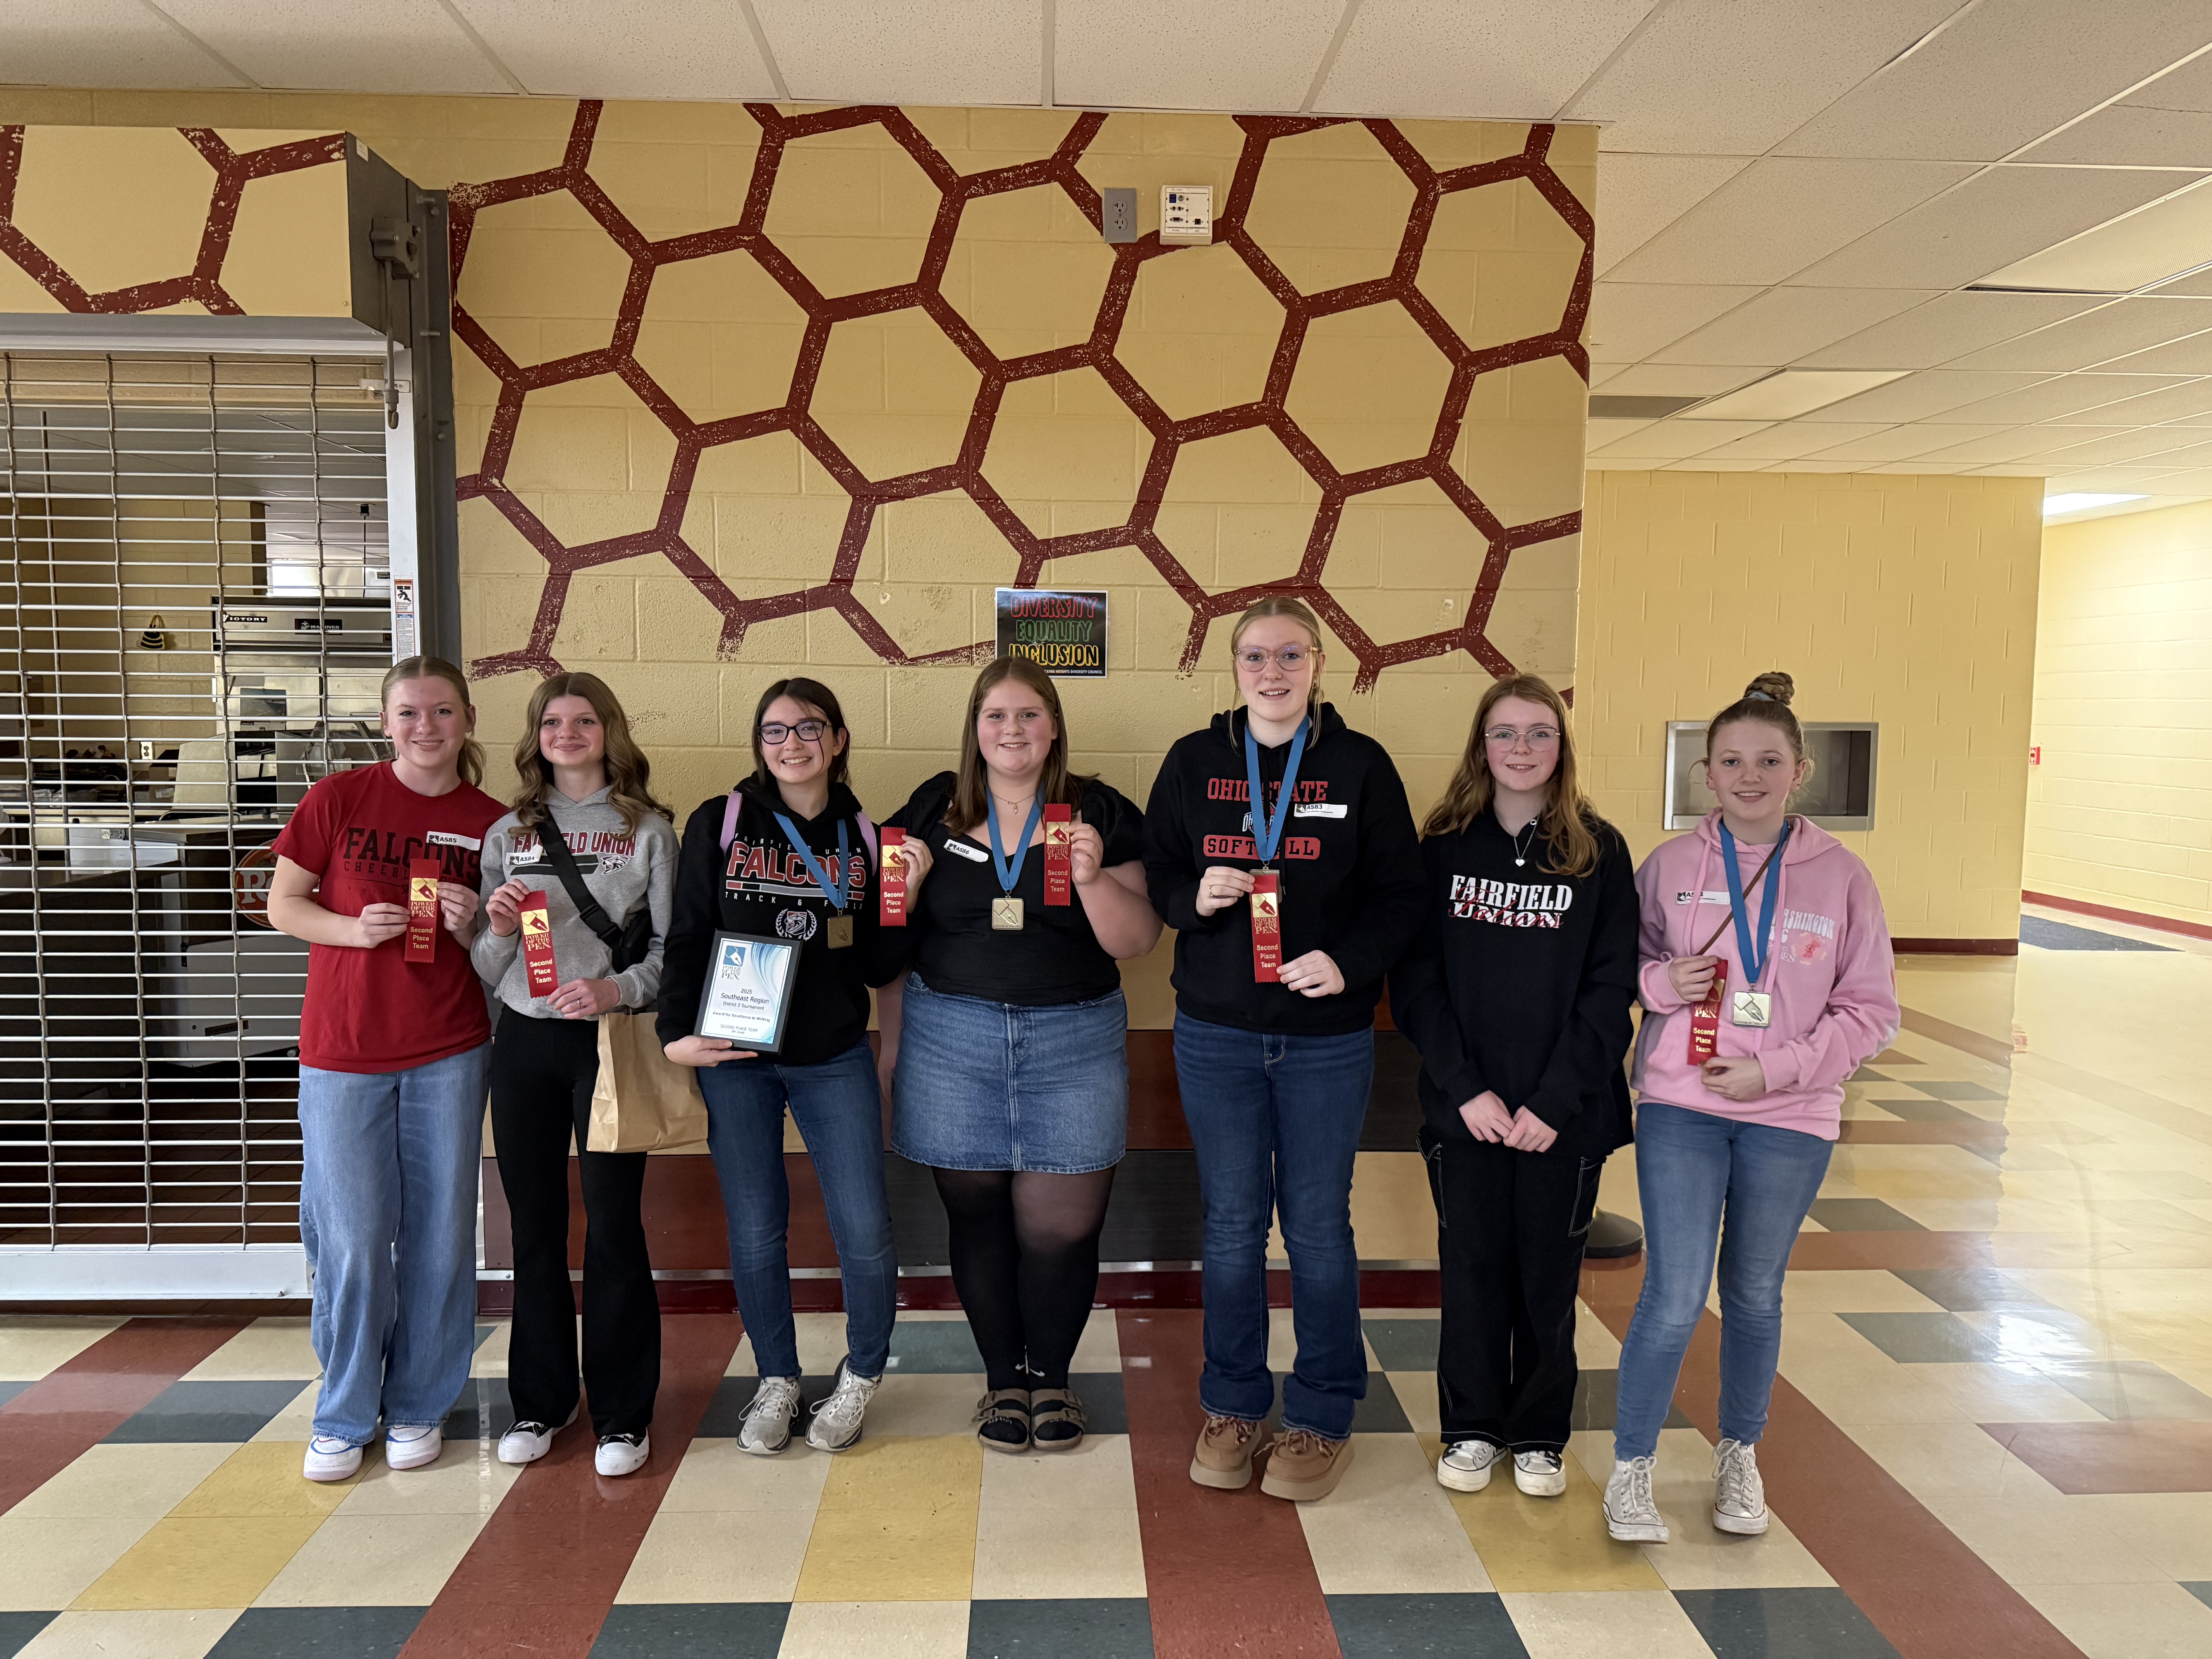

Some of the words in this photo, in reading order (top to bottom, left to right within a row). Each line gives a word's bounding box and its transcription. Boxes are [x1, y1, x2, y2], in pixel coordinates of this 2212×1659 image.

[1010, 595, 1098, 618] DIVERSITY
[223, 614, 266, 623] VICTORY
[1016, 620, 1092, 642] EQUALITY
[1009, 643, 1099, 666] INCLUSION
[591, 831, 638, 857] UNION
[955, 847, 970, 855] AS86
[1208, 838, 1314, 855] SOFTLL
[725, 891, 776, 904] TRACK
[1449, 874, 1573, 911] FAIRFIELD
[1453, 902, 1563, 929] UNION
[1782, 908, 1835, 940] ASHINGTON
[527, 942, 551, 951] PEN
[529, 958, 553, 967] Second
[721, 993, 749, 1002] Southeast
[750, 996, 769, 1005] Region
[1693, 1027, 1715, 1036] Second
